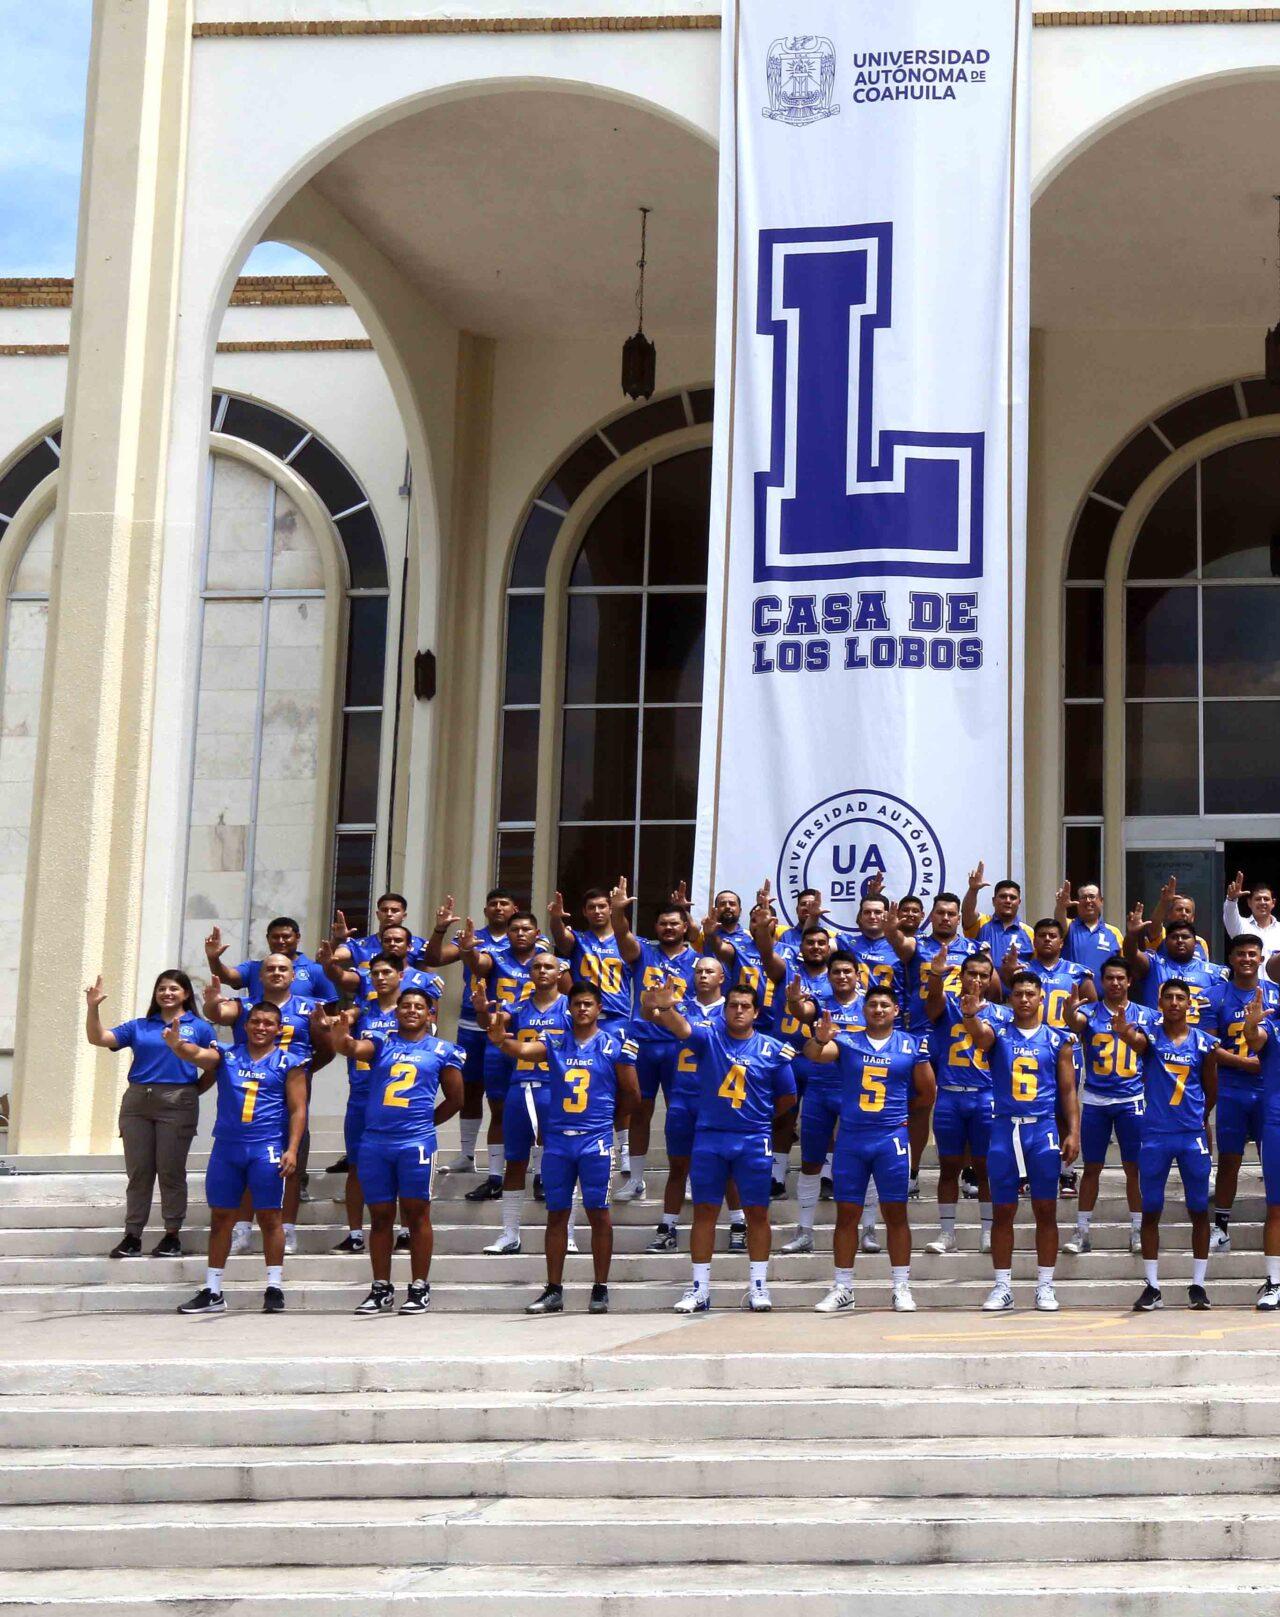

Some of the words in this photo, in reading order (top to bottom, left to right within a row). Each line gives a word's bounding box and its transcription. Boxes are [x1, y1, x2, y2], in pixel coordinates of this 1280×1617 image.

[853, 49, 990, 68] UNIVERSIDAD
[855, 65, 968, 86] AUTÓNOMA
[971, 70, 986, 80] DE
[853, 85, 956, 103] COAHUILA
[753, 221, 985, 583] L
[752, 590, 889, 637] CASA
[909, 592, 978, 632] DE
[752, 639, 830, 674] LOS
[845, 636, 983, 671] LOBOS
[789, 801, 867, 899] UNIVERSIDAD
[877, 805, 933, 898] AUTÓNOMA
[833, 844, 886, 874] UA
[831, 881, 855, 896] DE
[1098, 933, 1109, 947] L
[783, 948, 791, 959] L
[966, 943, 975, 955] L
[581, 955, 621, 992] 90
[1069, 964, 1077, 974] L
[1204, 963, 1215, 973] L
[412, 973, 421, 984] L
[1269, 990, 1277, 1004] L
[299, 1003, 308, 1014] L
[996, 1006, 1004, 1020] L
[1138, 1011, 1146, 1025] L
[434, 1042, 445, 1054] L
[603, 1040, 613, 1054] L
[902, 1040, 911, 1053] L
[1051, 1032, 1059, 1047] L
[1197, 1037, 1208, 1051] L
[761, 1042, 771, 1056] L
[1093, 1033, 1137, 1076] 30
[279, 1055, 287, 1068] L
[384, 1064, 416, 1106] 2
[719, 1066, 746, 1107] 4
[1013, 1058, 1037, 1100] 6
[1166, 1064, 1189, 1105] 7
[564, 1069, 590, 1112] 3
[860, 1067, 887, 1111] 5
[242, 1082, 258, 1122] 1
[1134, 1101, 1144, 1115] L
[598, 1140, 609, 1156] L
[764, 1139, 772, 1156] L
[893, 1138, 907, 1155] L
[1048, 1133, 1060, 1150] L
[1196, 1138, 1209, 1154] L
[268, 1146, 280, 1163] L
[418, 1146, 430, 1164] L
